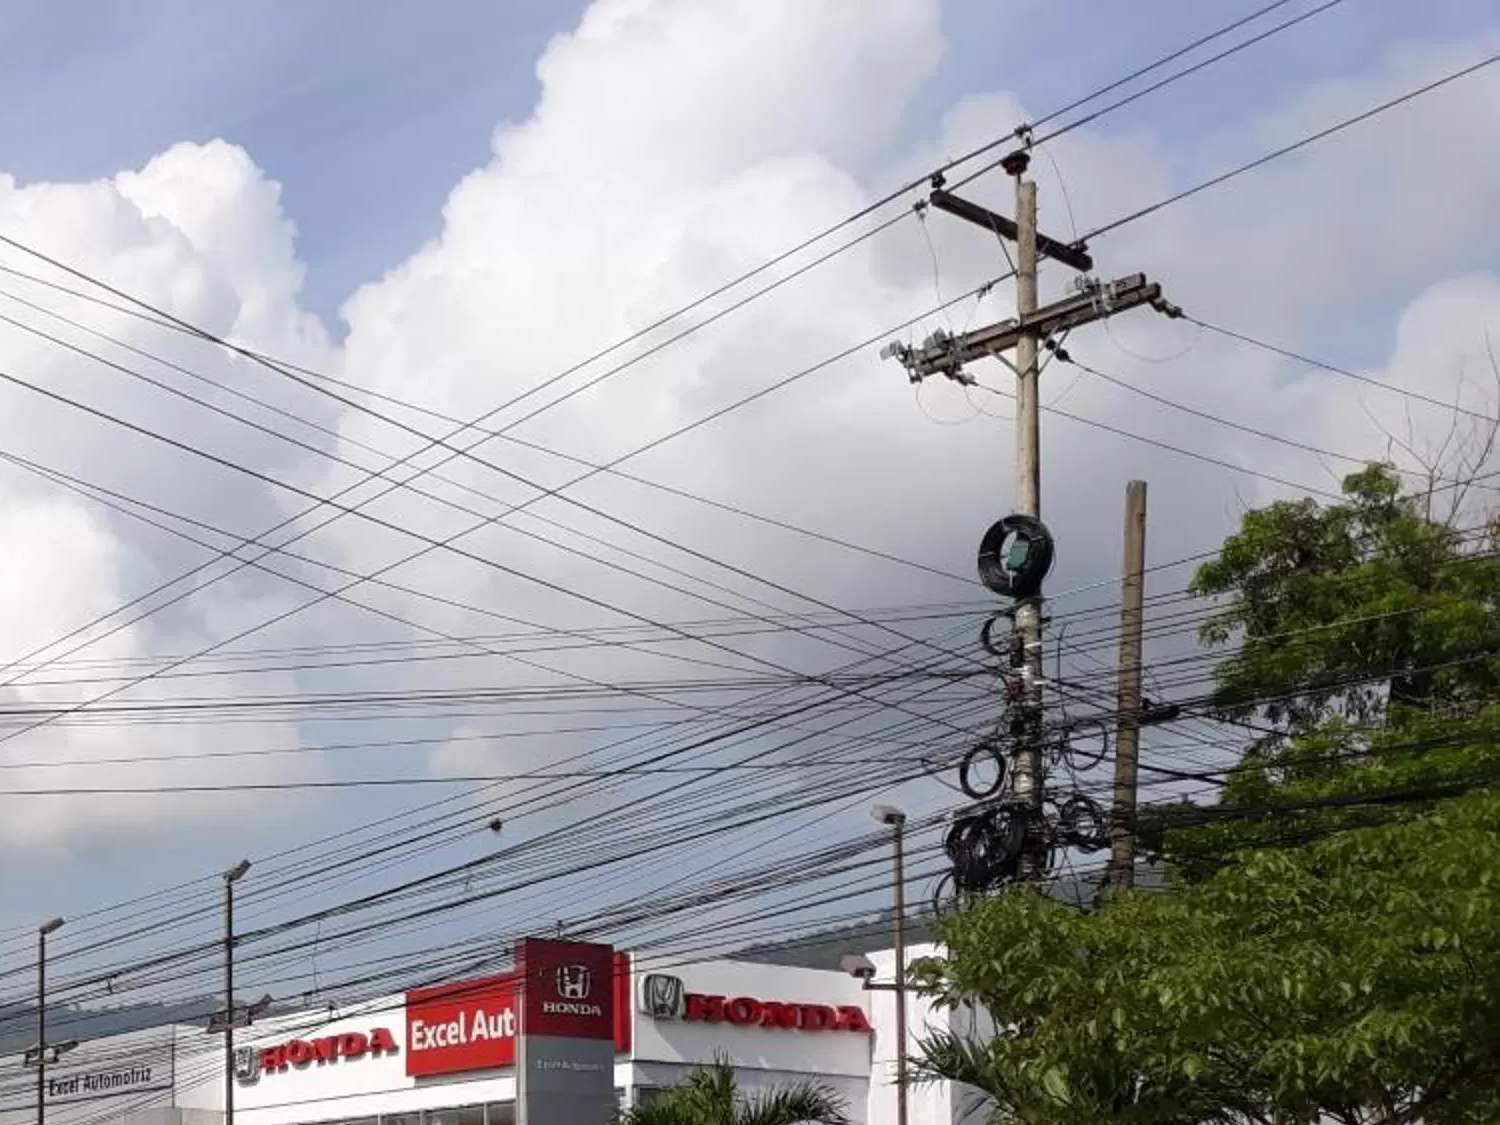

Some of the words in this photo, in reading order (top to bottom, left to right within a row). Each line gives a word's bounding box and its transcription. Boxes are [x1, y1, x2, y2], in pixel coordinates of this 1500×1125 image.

[543, 1001, 602, 1017] HONDA
[683, 993, 873, 1032] HONDA
[411, 1010, 467, 1051] Excel
[471, 1007, 516, 1042] Aut
[260, 1028, 397, 1070] HONDA
[49, 1076, 79, 1097] Excel
[84, 1067, 152, 1091] Automotriz
